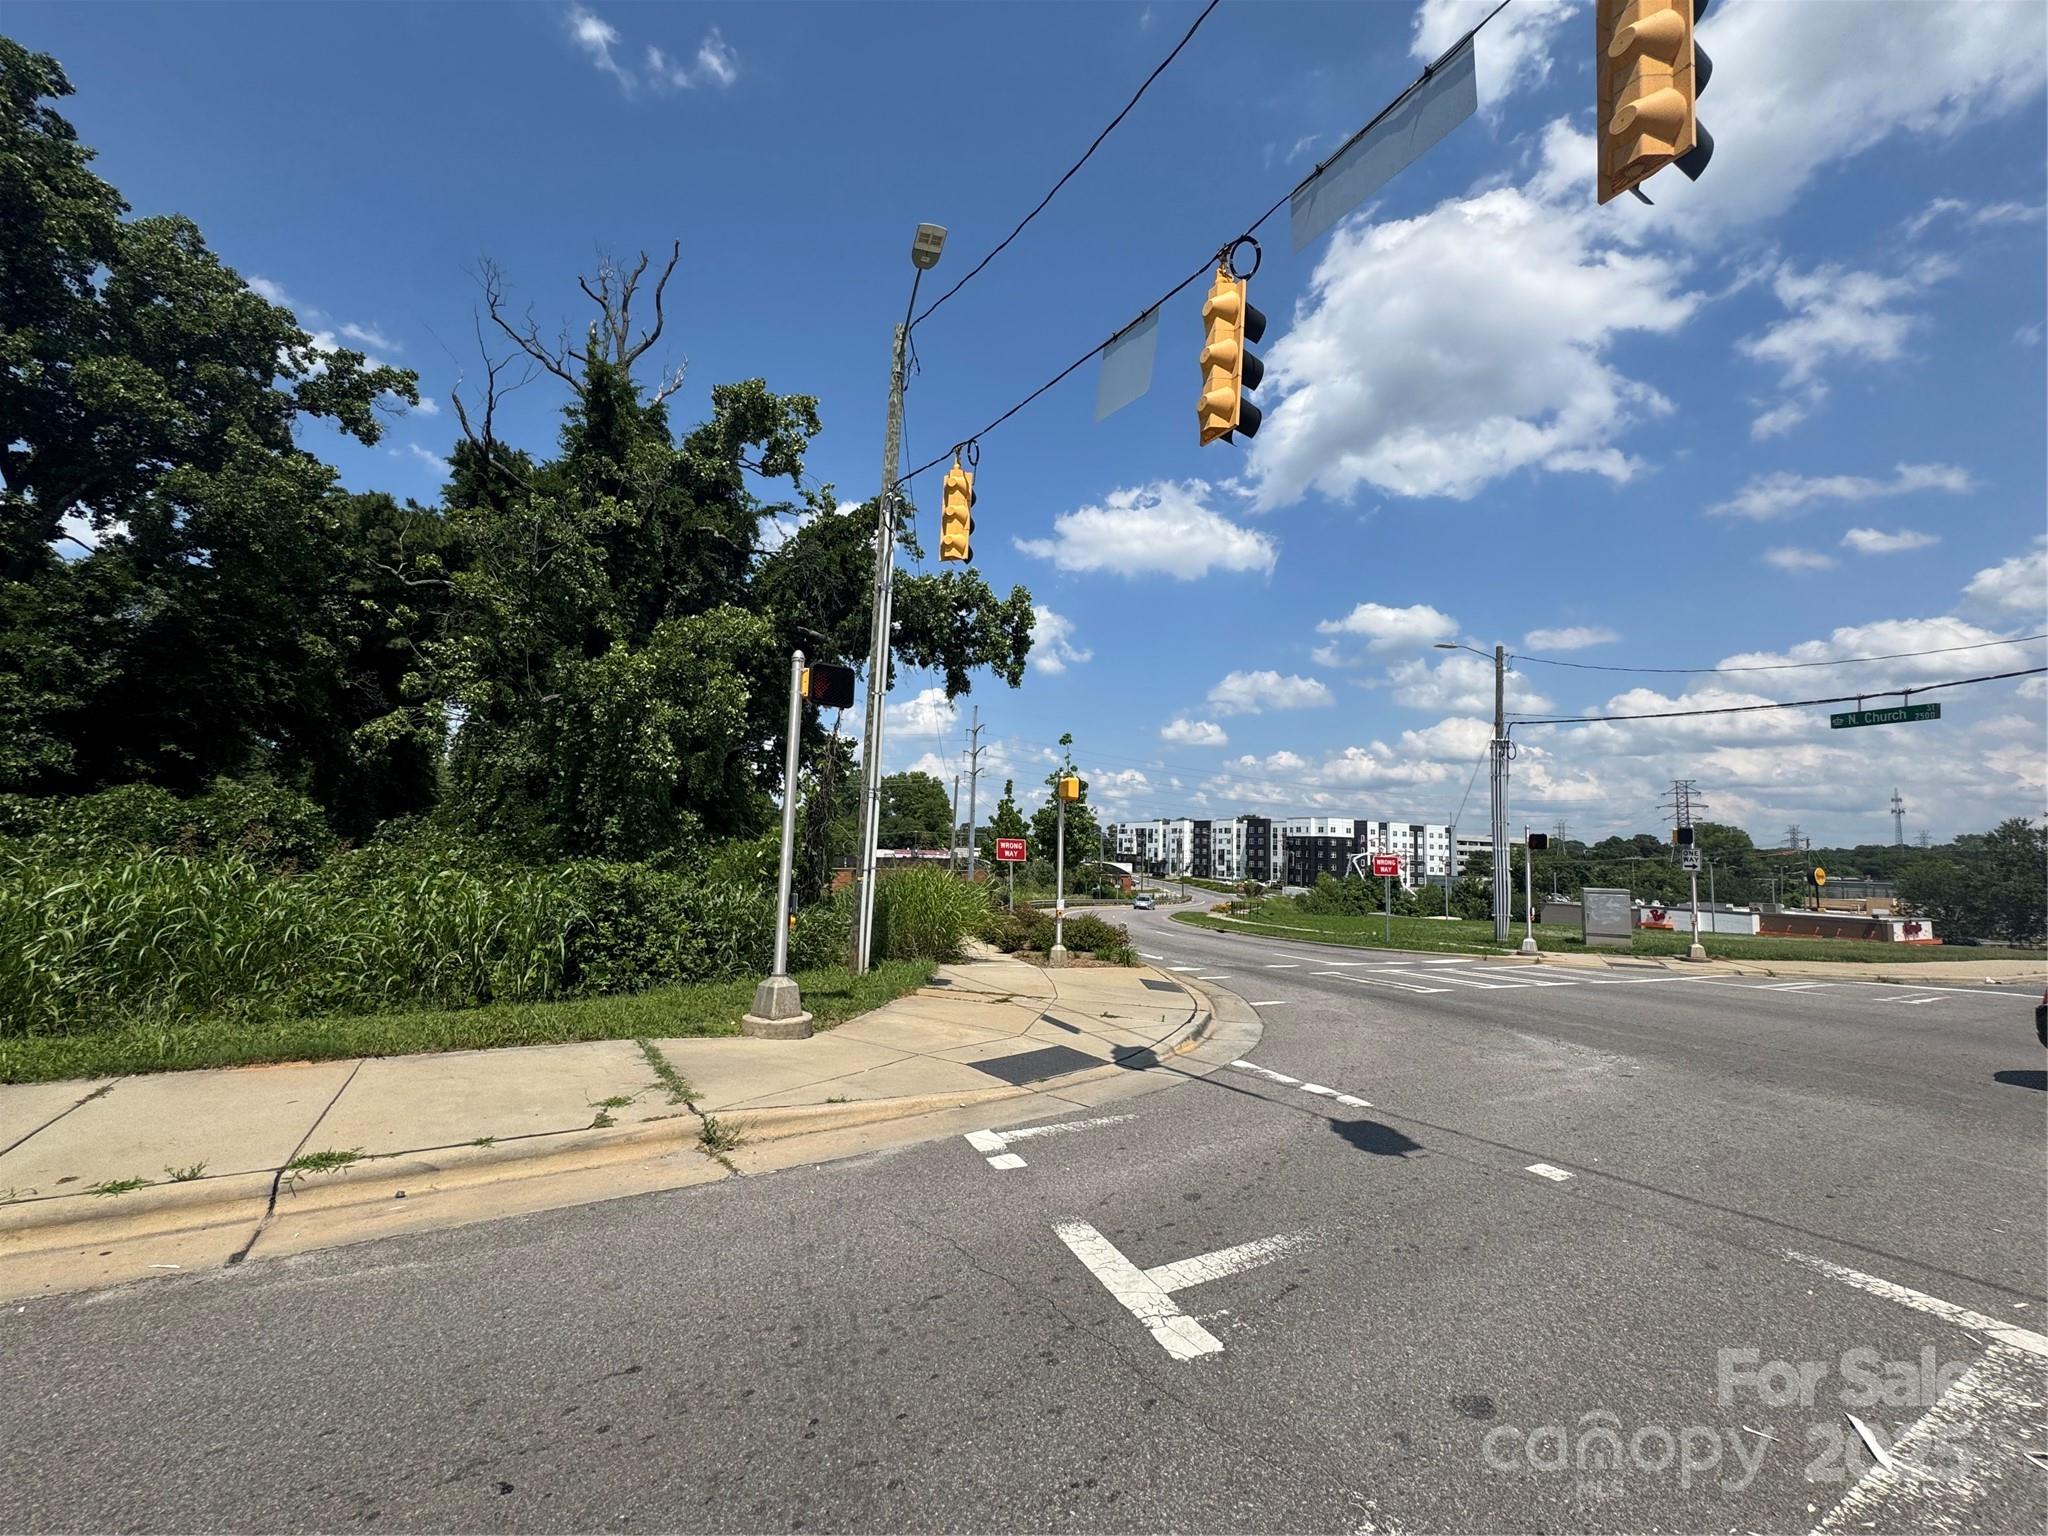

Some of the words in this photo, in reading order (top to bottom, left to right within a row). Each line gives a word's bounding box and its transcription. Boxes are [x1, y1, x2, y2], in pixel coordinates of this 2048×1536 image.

[1926, 704, 1936, 712] St
[1848, 714, 1859, 725] N.
[1864, 709, 1907, 723] Church
[1914, 711, 1936, 720] 2500
[1000, 842, 1023, 850] WRONG
